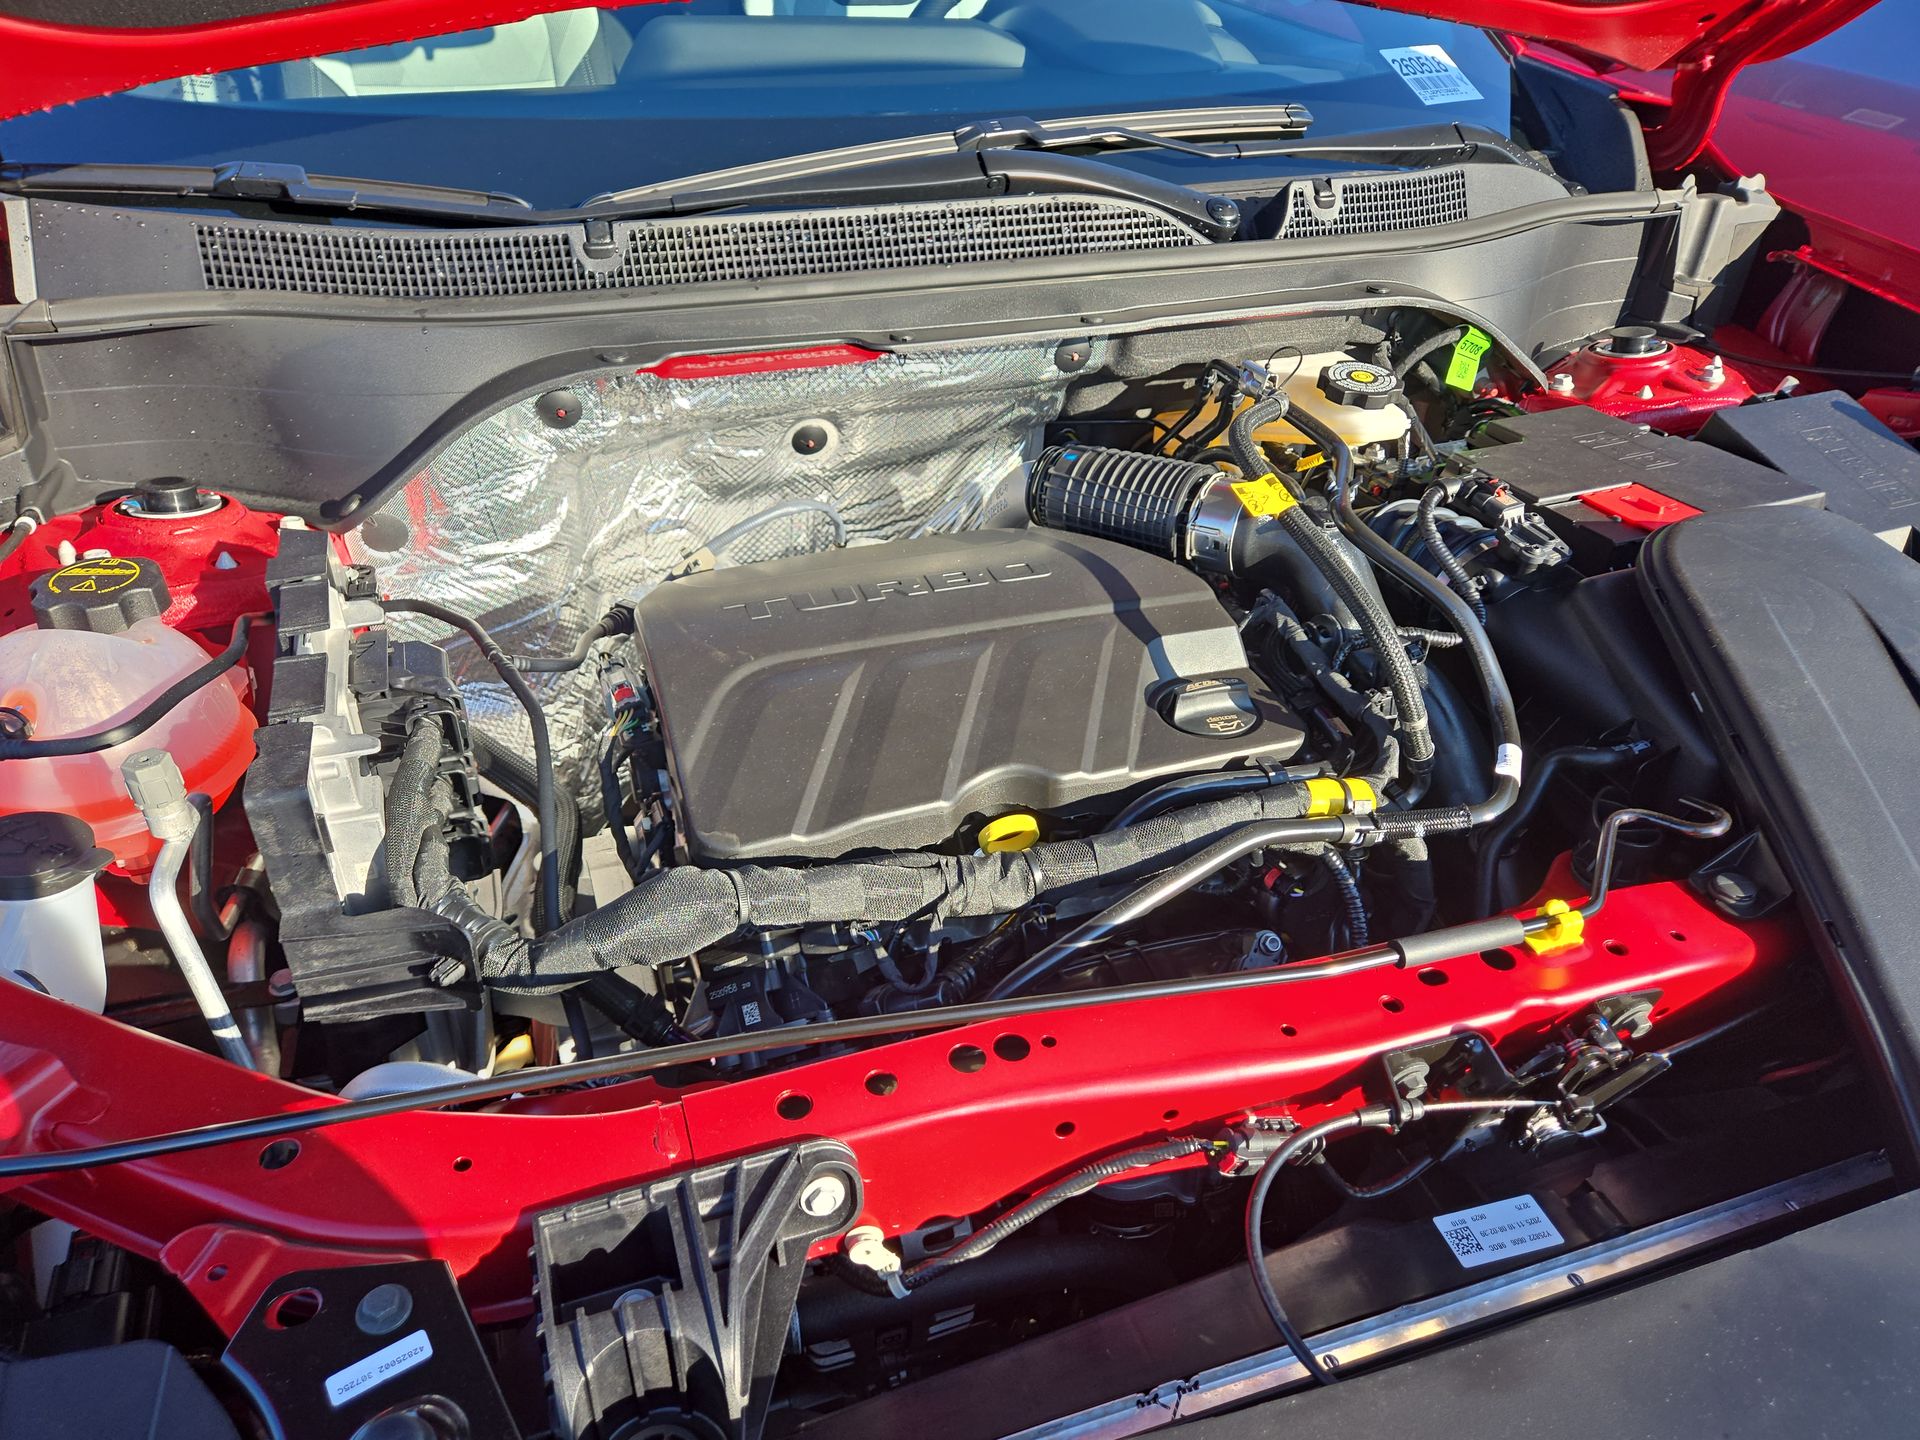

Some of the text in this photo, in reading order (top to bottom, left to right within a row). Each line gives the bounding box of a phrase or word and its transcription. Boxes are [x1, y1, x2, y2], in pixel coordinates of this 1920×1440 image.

[1391, 55, 1449, 76] 260518
[1460, 339, 1483, 356] 5708
[722, 562, 1054, 620] TURBO
[1206, 714, 1238, 723] dexos
[336, 1345, 425, 1395] 42825002 30725C
